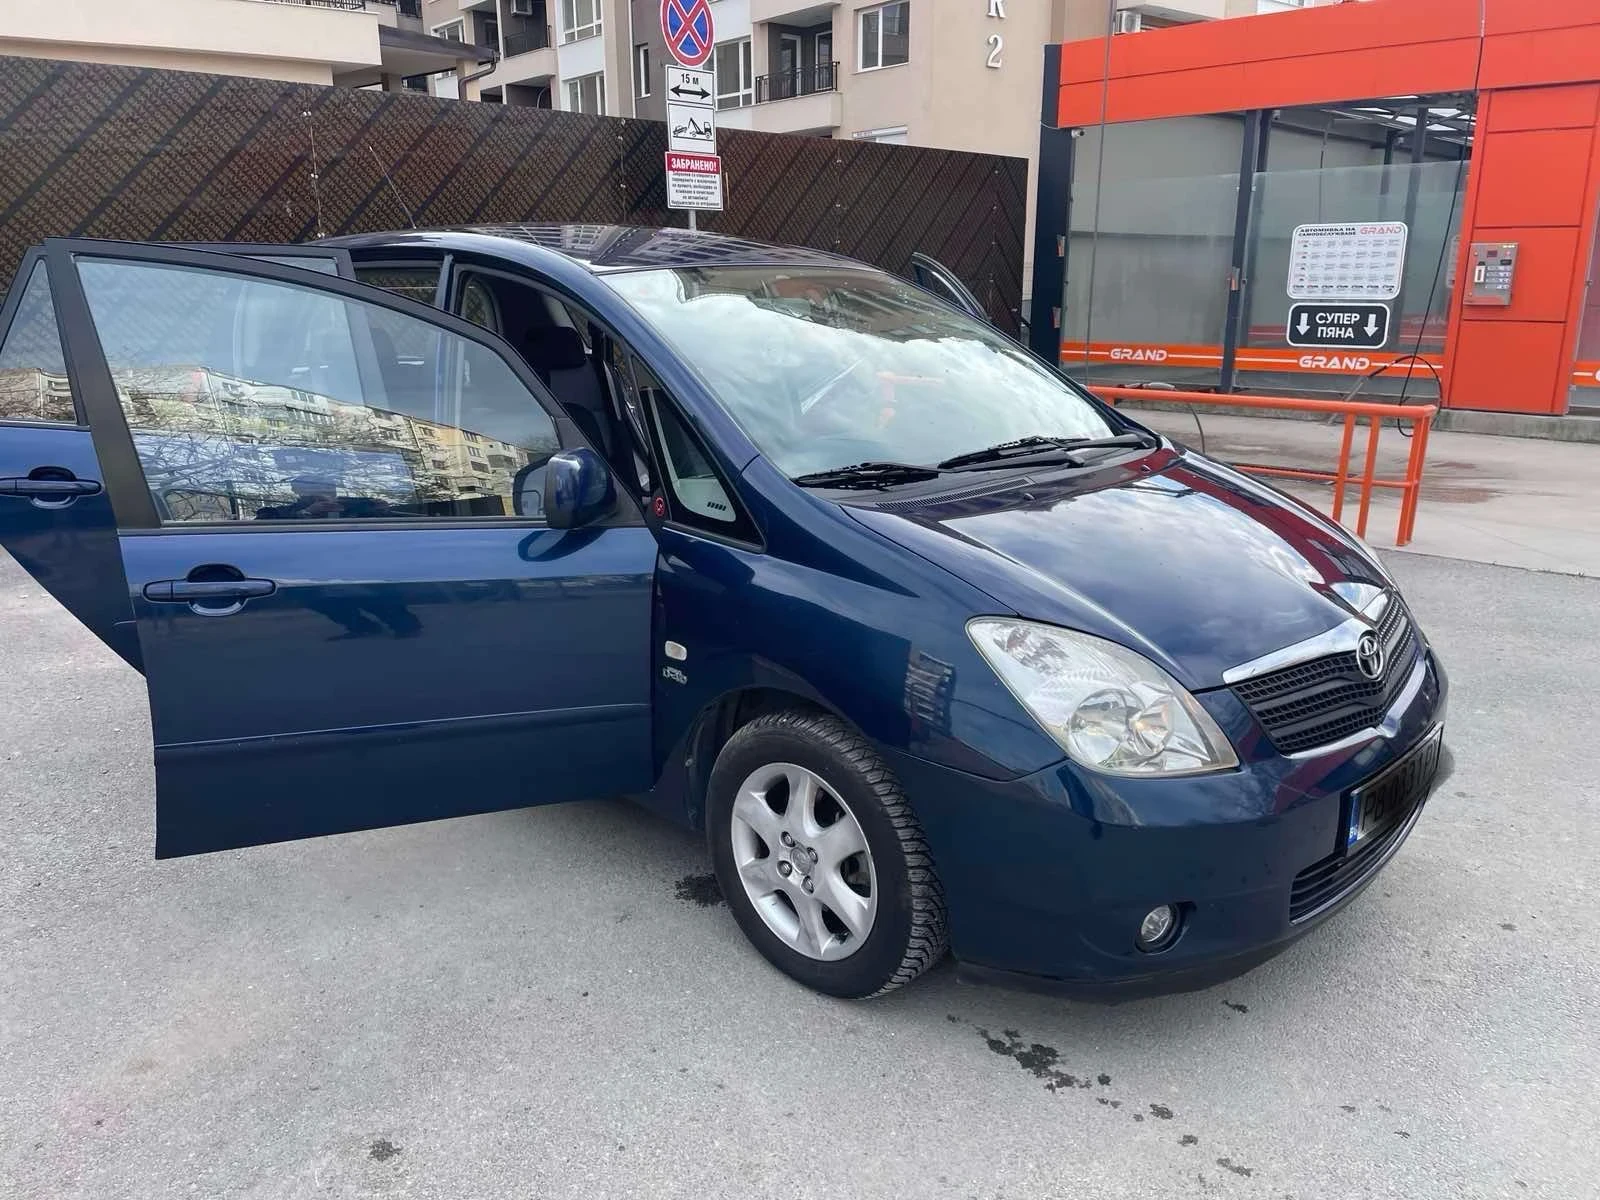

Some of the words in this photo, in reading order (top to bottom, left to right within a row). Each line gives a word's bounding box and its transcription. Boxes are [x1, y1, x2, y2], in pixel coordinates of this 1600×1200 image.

[987, 34, 1003, 68] 2
[681, 73, 690, 84] 15
[671, 158, 717, 171] ЗАБРАНЕНО!
[1360, 226, 1401, 235] GRAND
[1315, 312, 1360, 325] СУПЕР
[1317, 326, 1355, 339] ПЯНА
[1110, 347, 1168, 361] GRAND
[1299, 355, 1370, 370] GRAND
